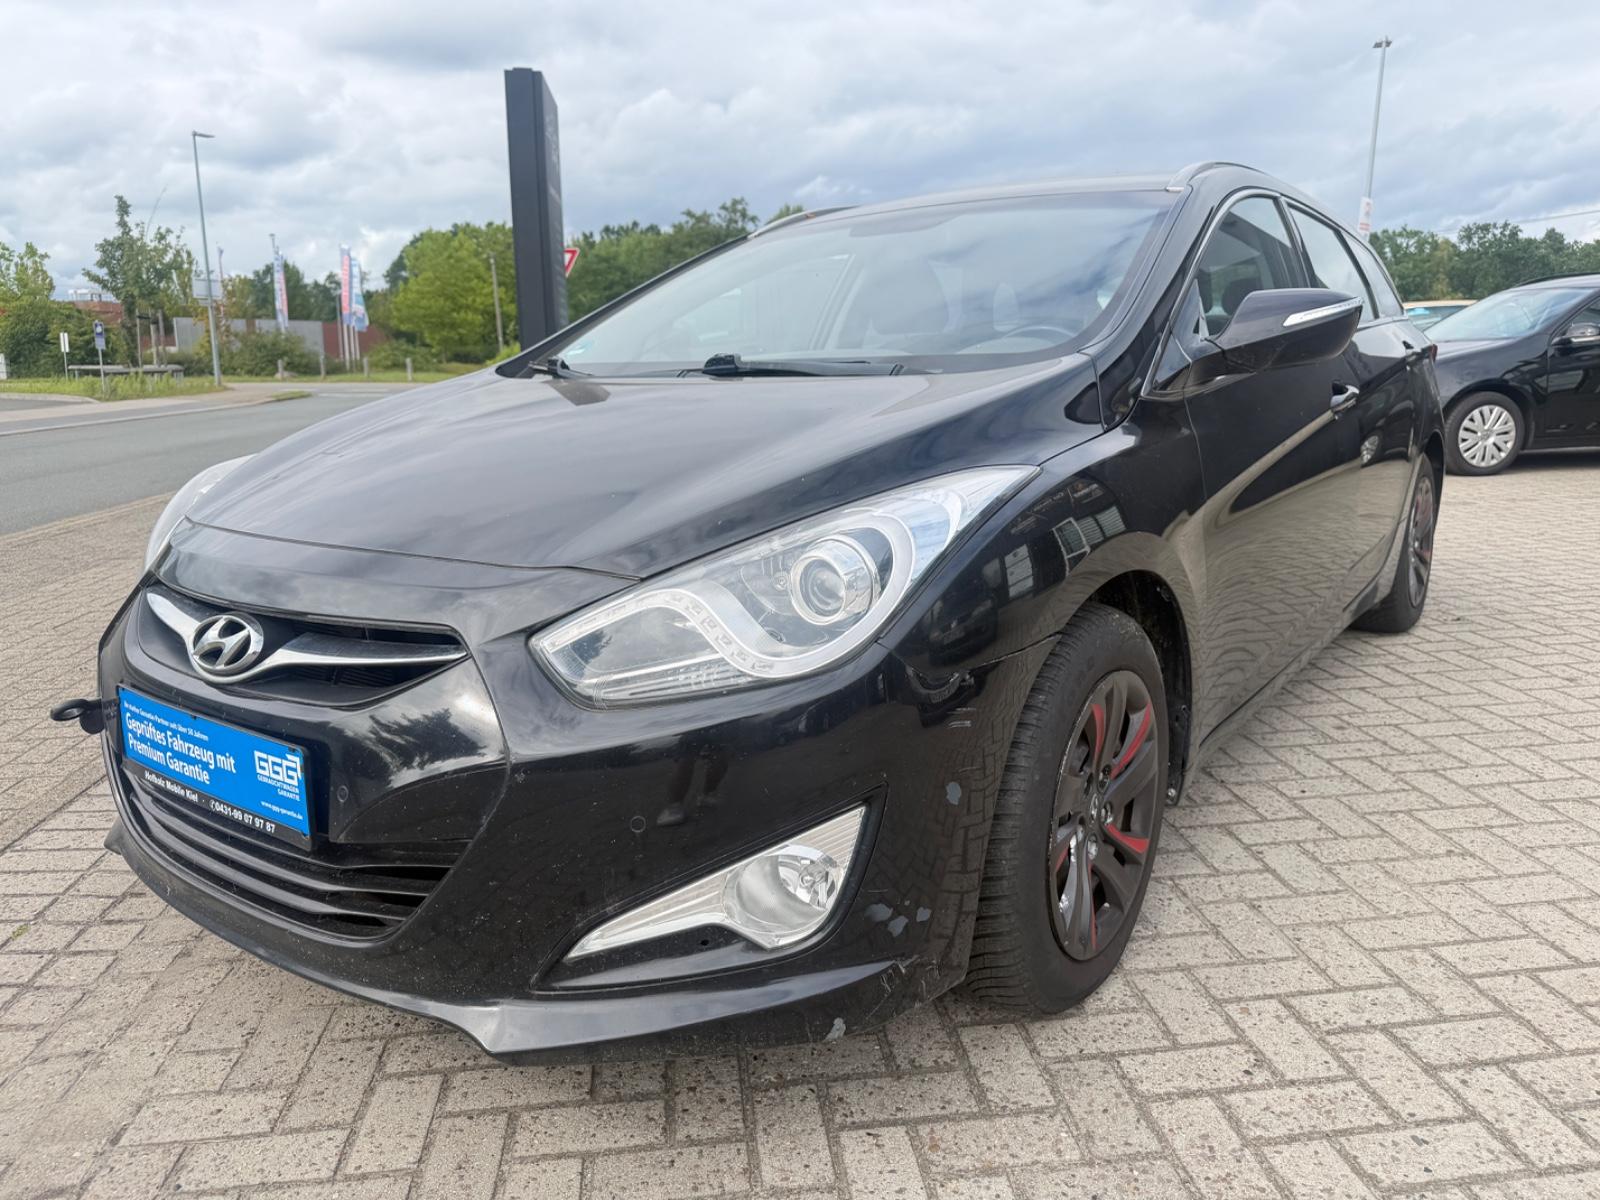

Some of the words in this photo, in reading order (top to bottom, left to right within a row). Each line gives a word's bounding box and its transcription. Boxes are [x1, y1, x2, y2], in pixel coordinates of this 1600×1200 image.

[126, 712, 166, 746] Geprüftes
[167, 730, 215, 770] Fahrzeug
[216, 752, 237, 773] mit
[128, 733, 167, 766] Premium
[166, 752, 211, 785] Garantie
[253, 750, 301, 786] GGG
